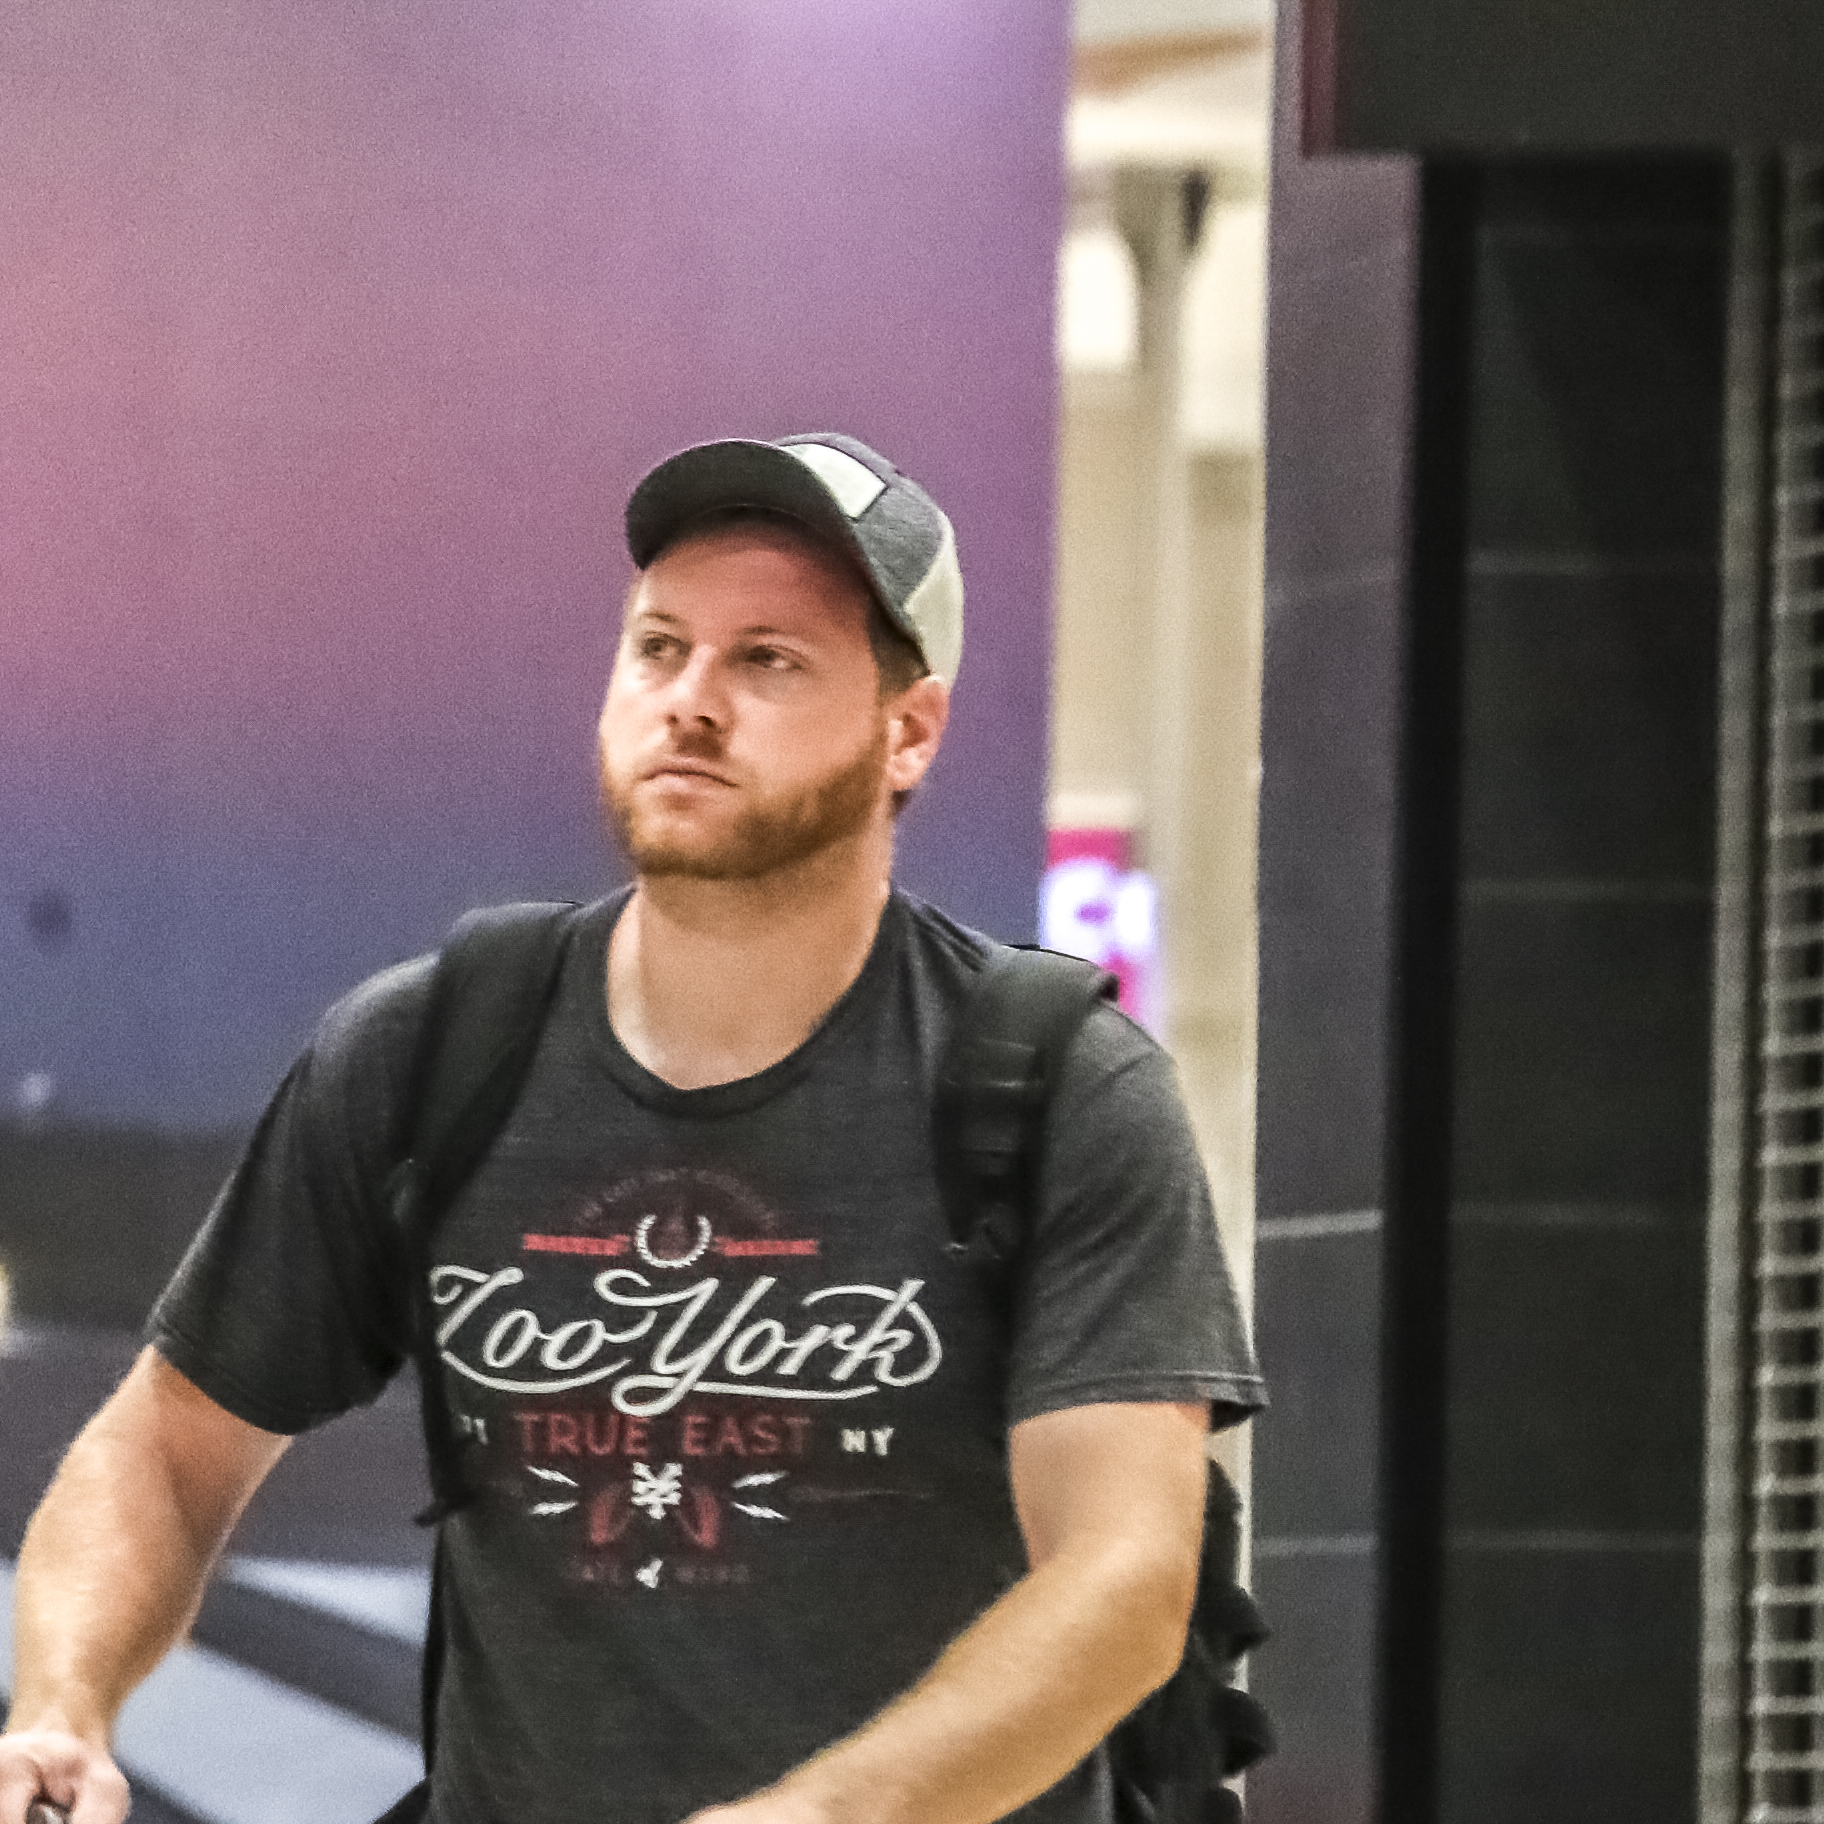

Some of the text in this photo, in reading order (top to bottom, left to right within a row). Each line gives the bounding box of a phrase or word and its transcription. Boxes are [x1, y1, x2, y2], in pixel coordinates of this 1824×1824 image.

[429, 1264, 944, 1418] Zoo York
[512, 1411, 651, 1457] TRUE
[681, 1412, 812, 1458] EAST
[841, 1426, 895, 1457] NY
